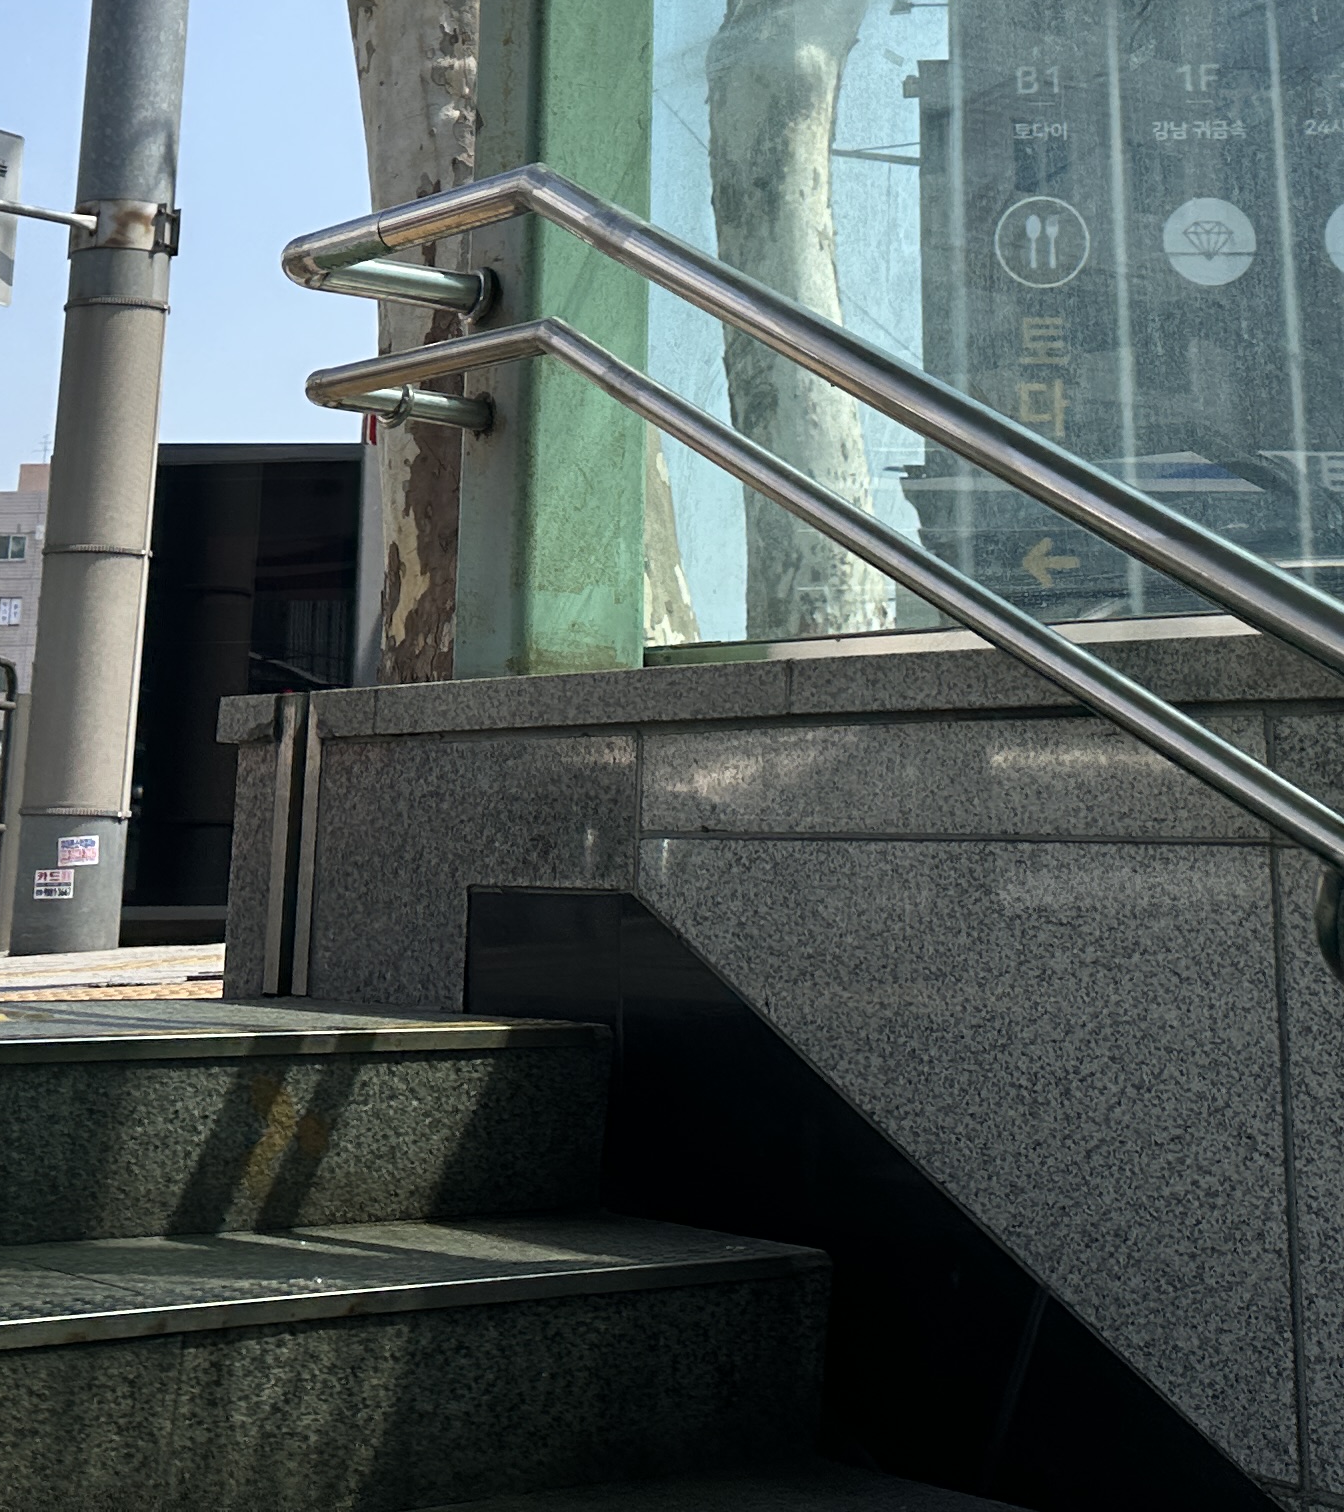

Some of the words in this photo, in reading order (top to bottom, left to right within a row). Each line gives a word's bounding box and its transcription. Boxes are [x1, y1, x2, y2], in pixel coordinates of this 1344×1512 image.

[1016, 65, 1060, 94] B1
[1176, 63, 1220, 92] 1F
[1013, 122, 1068, 140] 토다이
[1152, 121, 1188, 141] 강남
[1192, 119, 1248, 140] 귀금속
[1018, 317, 1070, 438] 토다
